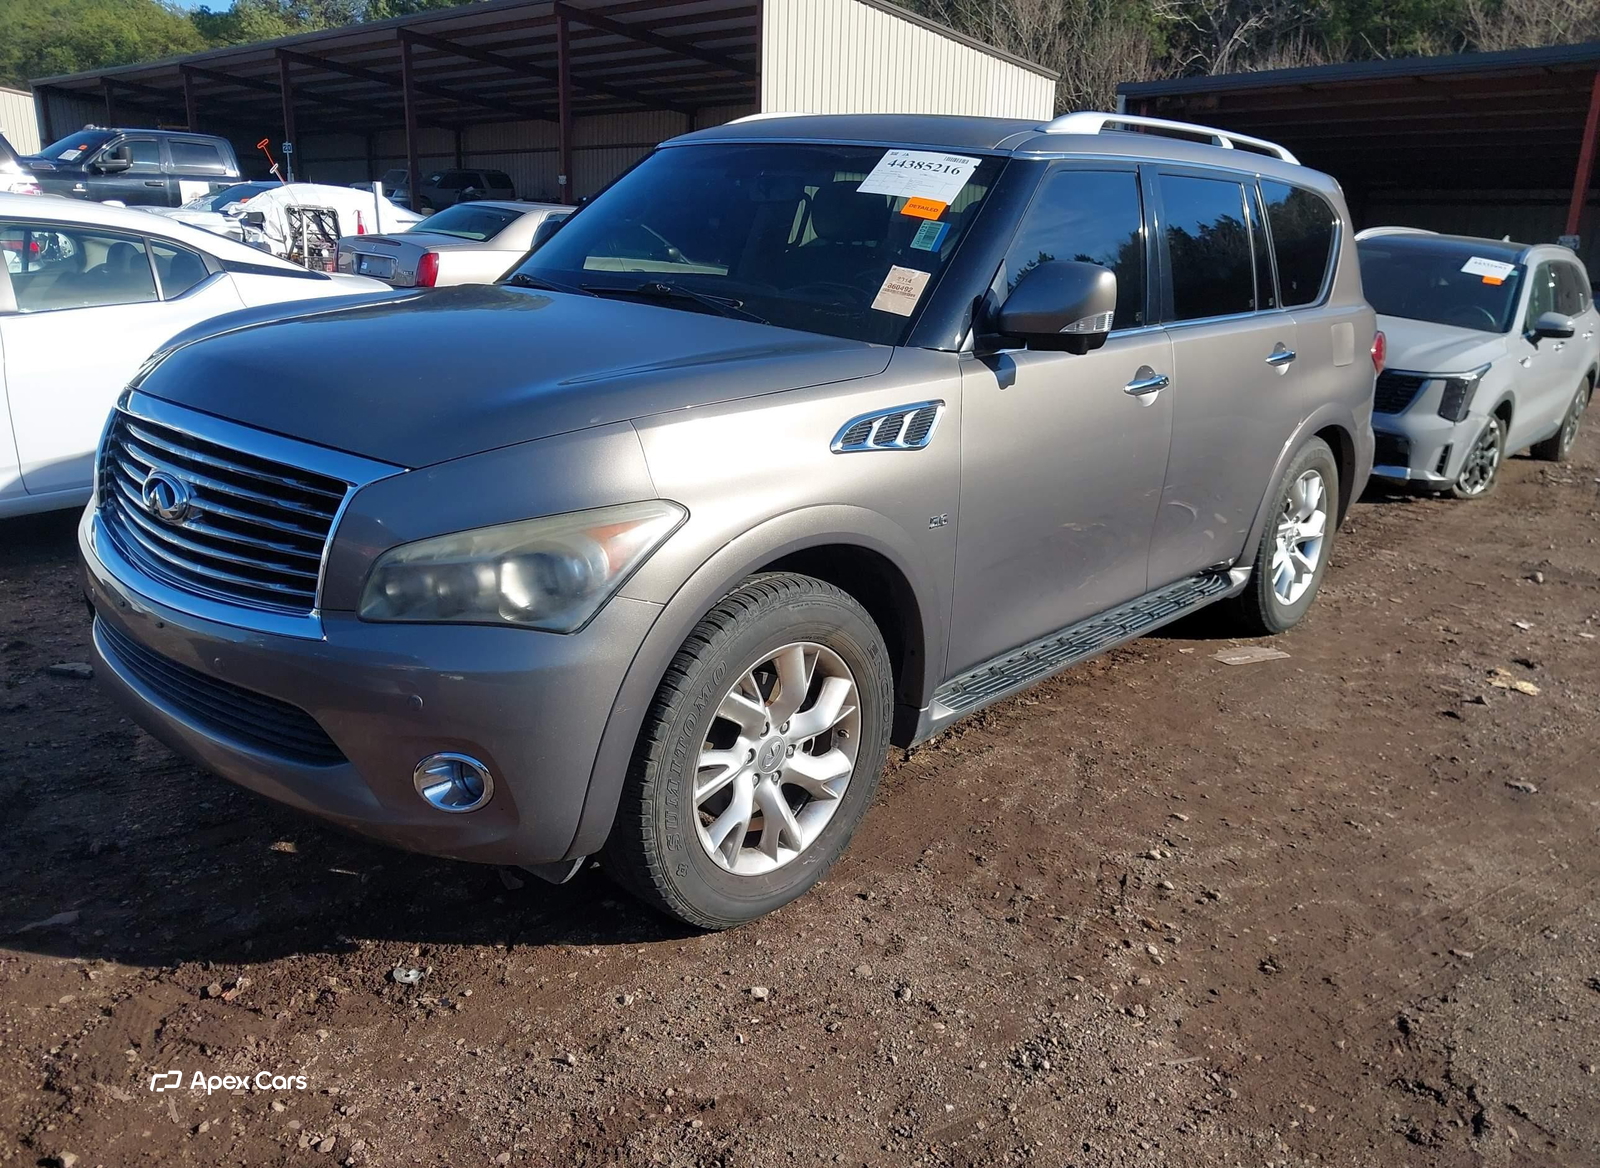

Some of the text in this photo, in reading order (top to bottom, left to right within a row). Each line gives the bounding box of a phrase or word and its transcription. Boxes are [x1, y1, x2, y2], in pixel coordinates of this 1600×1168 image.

[887, 159, 963, 176] 44385216
[908, 203, 939, 213] DETAILED
[664, 660, 728, 852] SUMITOMO
